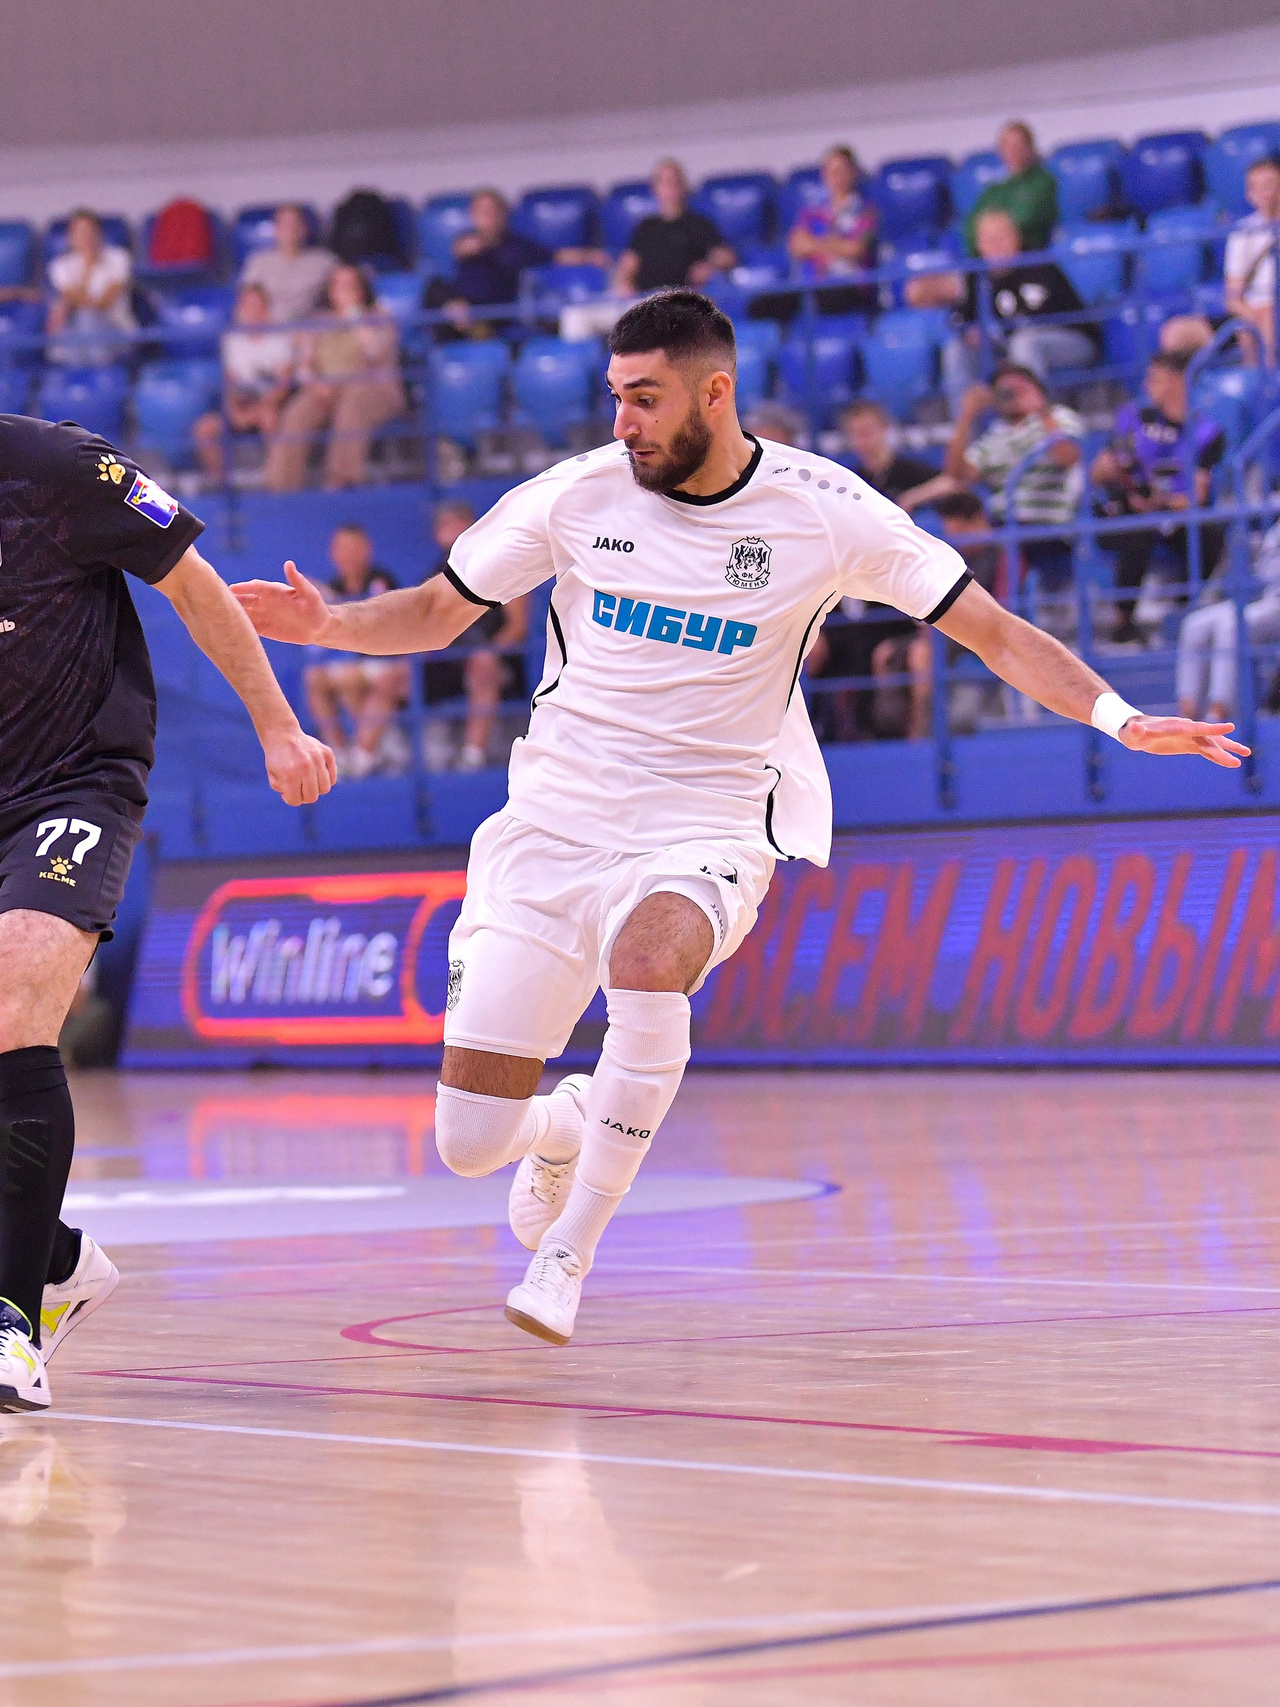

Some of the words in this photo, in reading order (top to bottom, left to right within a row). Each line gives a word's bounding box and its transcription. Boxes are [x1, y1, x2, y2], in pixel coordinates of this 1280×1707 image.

[592, 536, 634, 553] JAKO
[728, 574, 766, 588] ТЮМЕНЬ
[592, 588, 758, 655] СИБУР
[35, 817, 102, 866] 77
[38, 871, 77, 887] KELME
[600, 1117, 651, 1139] JAKO
